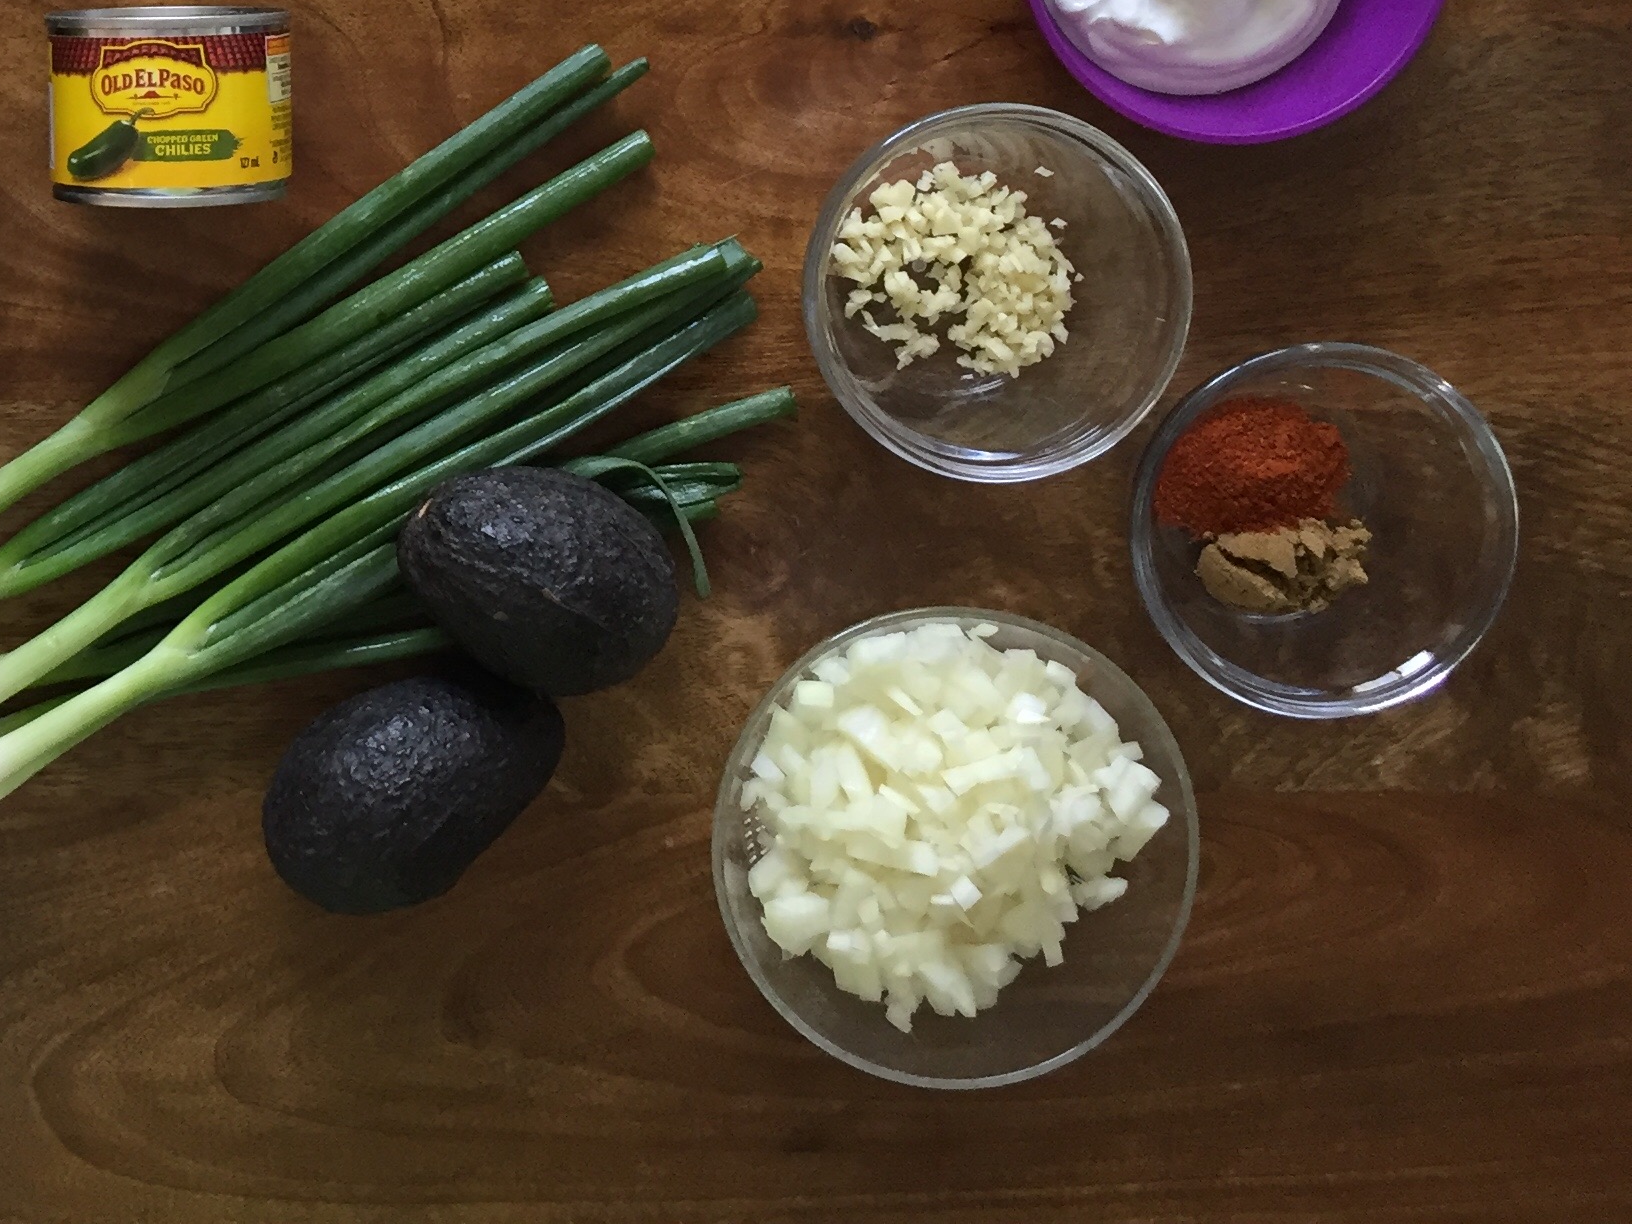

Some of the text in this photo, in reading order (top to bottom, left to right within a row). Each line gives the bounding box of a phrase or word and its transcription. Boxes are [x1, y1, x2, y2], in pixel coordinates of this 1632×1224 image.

[101, 73, 133, 96] OLD
[147, 133, 218, 144] CHOPPED GREEN
[154, 143, 211, 156] CHILIES
